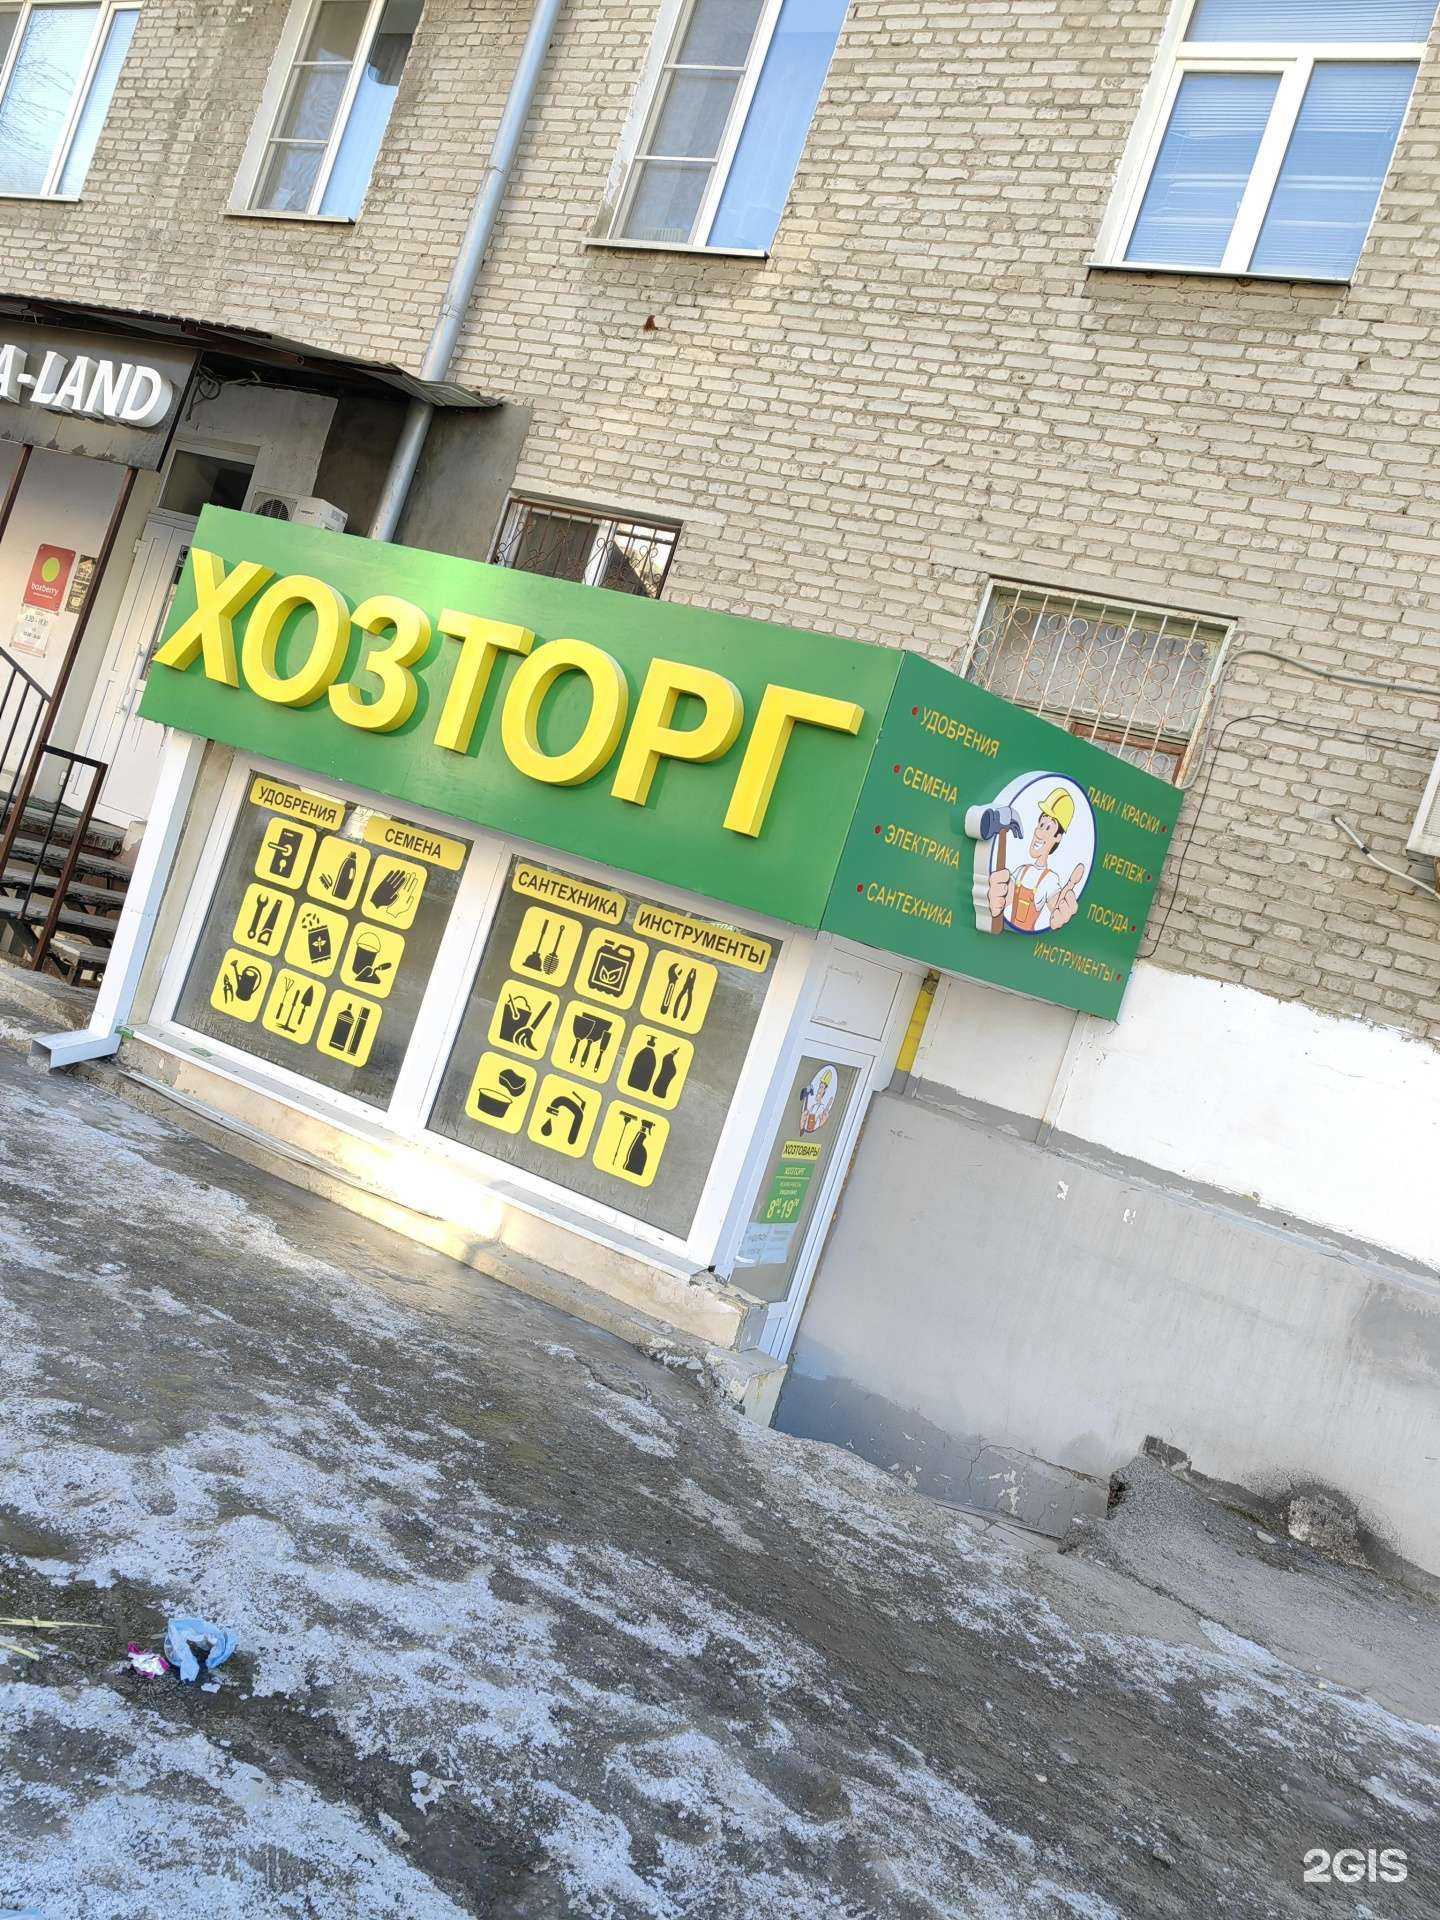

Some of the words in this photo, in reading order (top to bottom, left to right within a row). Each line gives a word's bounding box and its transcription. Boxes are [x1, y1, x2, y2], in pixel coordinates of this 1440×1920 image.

[152, 547, 865, 840] ХОЗТОРГ
[920, 706, 1000, 759] УДОБРЕНИЯ
[258, 786, 337, 824] УДОБРЕНИЯ
[902, 766, 959, 806] СЕМЕНА
[1121, 803, 1161, 834] КРАСКИ
[385, 828, 441, 859] СЕМЕНА
[884, 824, 961, 869] ЭЛЕКТРИКА
[1103, 851, 1148, 885] КРЕПЕЖ
[518, 871, 618, 917] САНТЕХНИКА
[867, 882, 953, 928] САНТЕХНИКА
[639, 911, 766, 966] ИНСТРУМЕНТЫ
[1087, 903, 1129, 933] ПОСУДА
[1034, 940, 1113, 982] ИНСТРУМЕНТЫ
[783, 1144, 820, 1157] ХОЗТОВАРЫ
